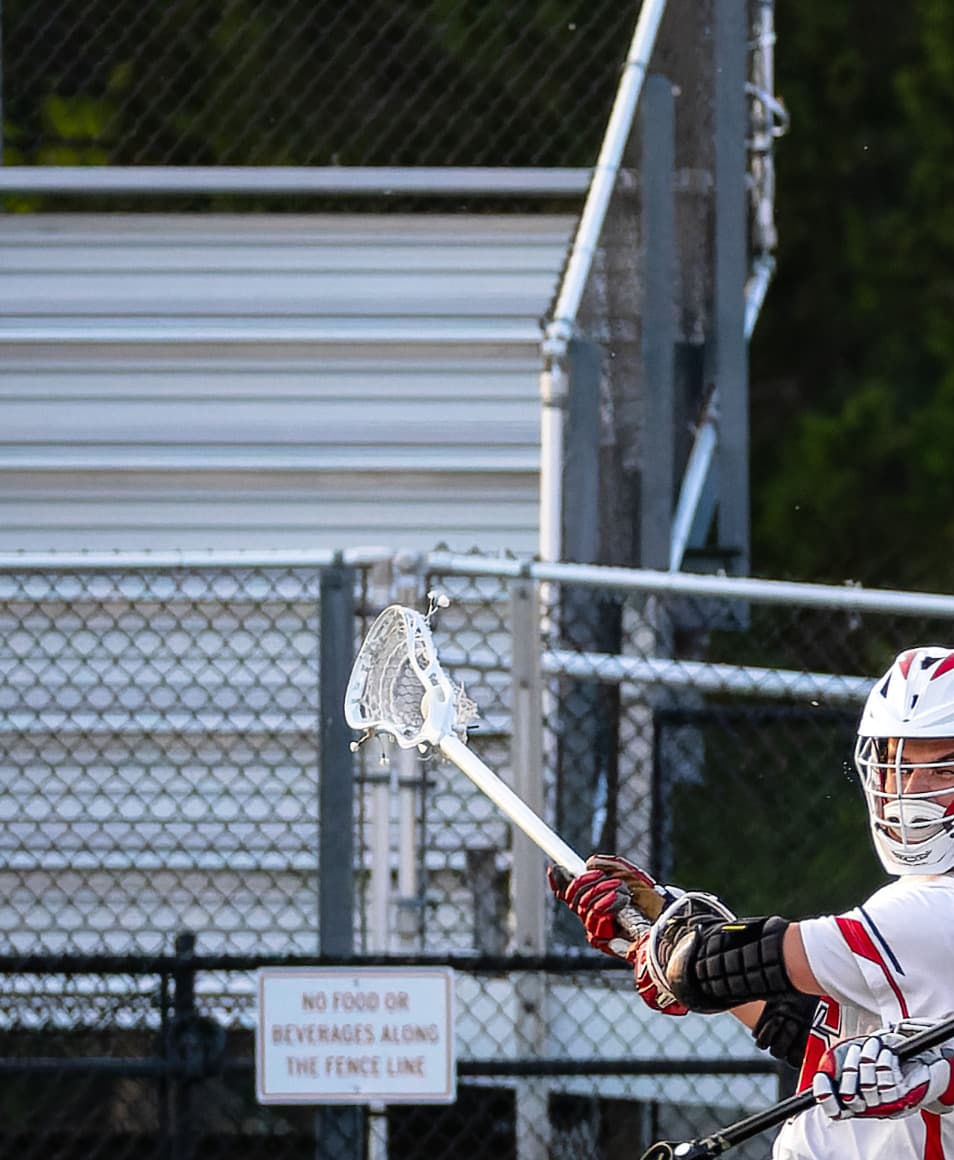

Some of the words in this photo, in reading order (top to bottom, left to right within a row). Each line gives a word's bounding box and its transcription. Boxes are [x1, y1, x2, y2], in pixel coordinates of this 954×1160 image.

[302, 991, 327, 1011] NO
[333, 991, 380, 1011] FOOD
[385, 991, 410, 1011] OR
[272, 1024, 375, 1043] BEVERAGES
[380, 1024, 439, 1043] ALONG
[287, 1056, 318, 1076] THE
[325, 1056, 380, 1075] FENCE
[386, 1056, 424, 1076] LINE
